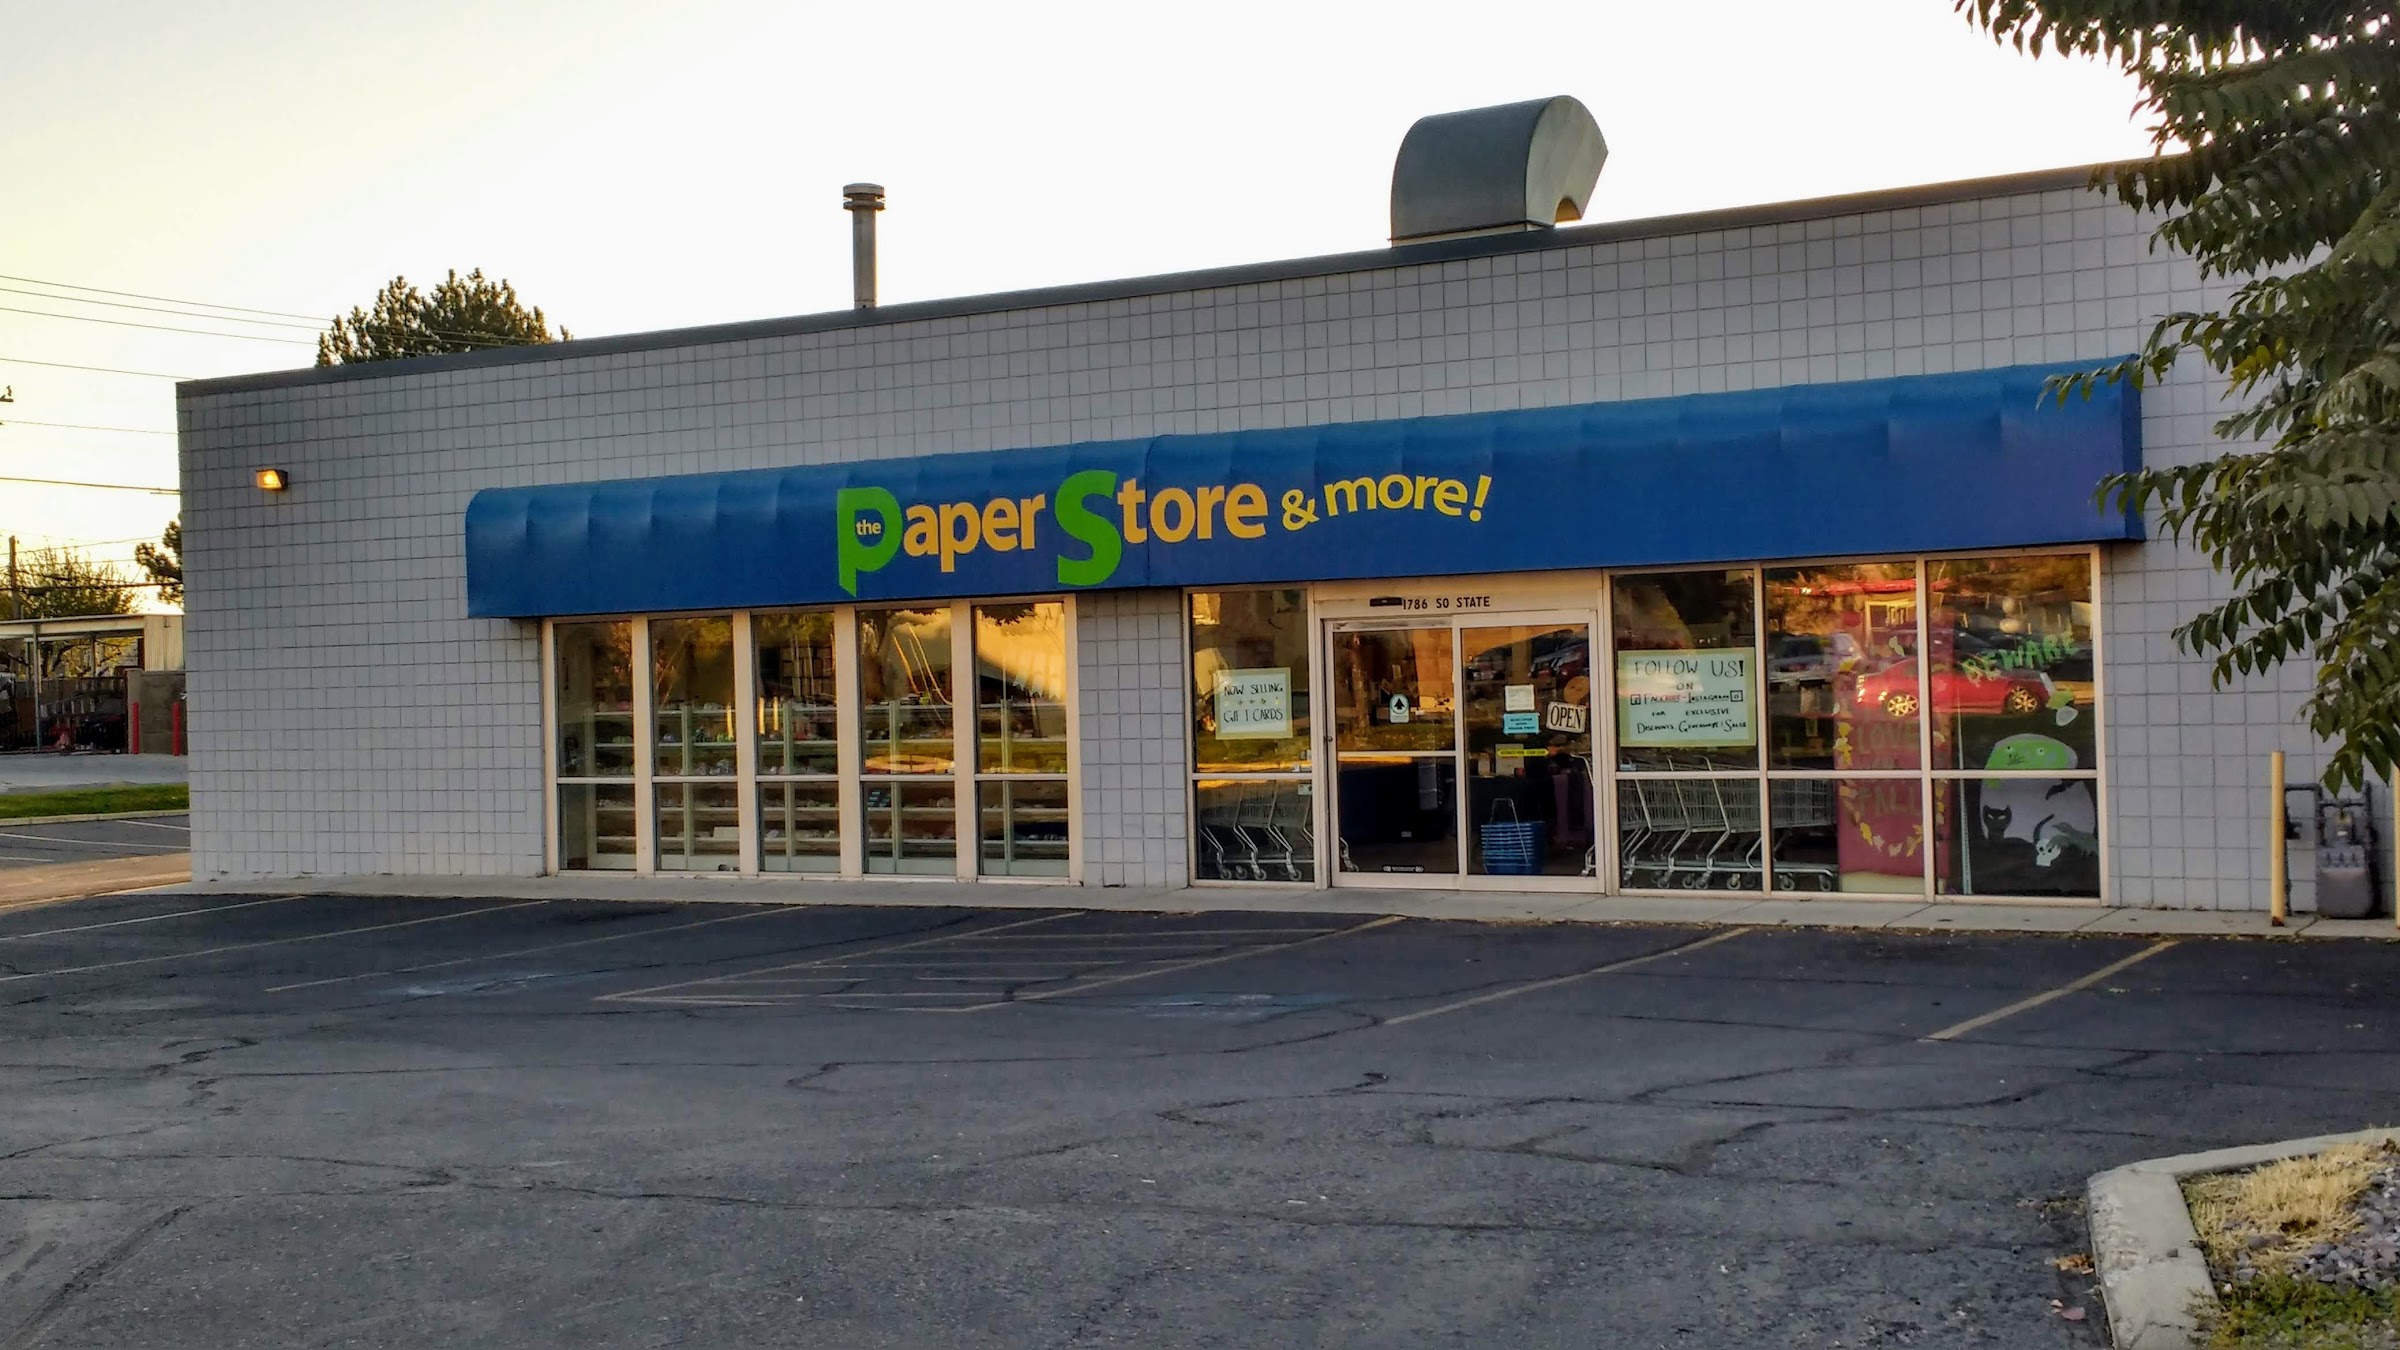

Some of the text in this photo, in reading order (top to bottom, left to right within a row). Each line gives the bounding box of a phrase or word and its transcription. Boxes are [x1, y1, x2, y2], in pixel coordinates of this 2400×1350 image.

[837, 470, 1493, 597] Paper Store & more!
[855, 518, 882, 536] the
[1403, 596, 1491, 610] 1786 SO STATE
[1634, 659, 1744, 678] FOLLOW US!
[1224, 683, 1284, 697] NOW SELLING
[1676, 682, 1694, 691] ON
[1252, 708, 1284, 722] CARDS
[1550, 705, 1583, 730] OPEN
